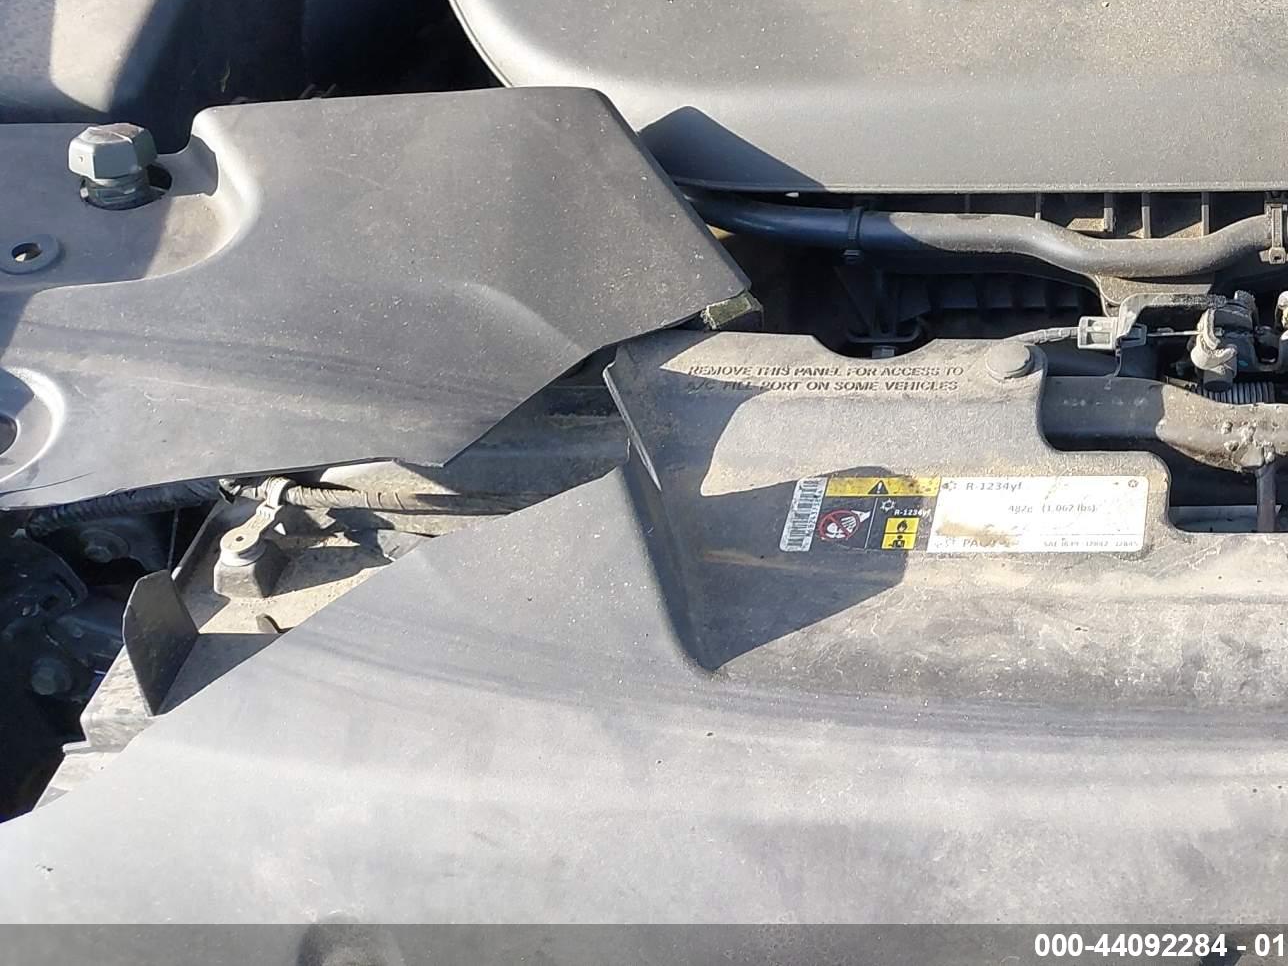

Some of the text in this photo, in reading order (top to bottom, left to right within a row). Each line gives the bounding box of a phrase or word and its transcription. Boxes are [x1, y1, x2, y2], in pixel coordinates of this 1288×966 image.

[688, 365, 964, 376] REMOVE THIS PANEL FOR ACCESS TO
[723, 381, 751, 391] FILL
[760, 381, 801, 391] PORT
[806, 381, 830, 391] ON
[834, 381, 880, 391] SOME
[884, 381, 958, 391] VEHICLES
[966, 482, 1023, 492] R-1234yf
[894, 509, 932, 520] R-1234yf
